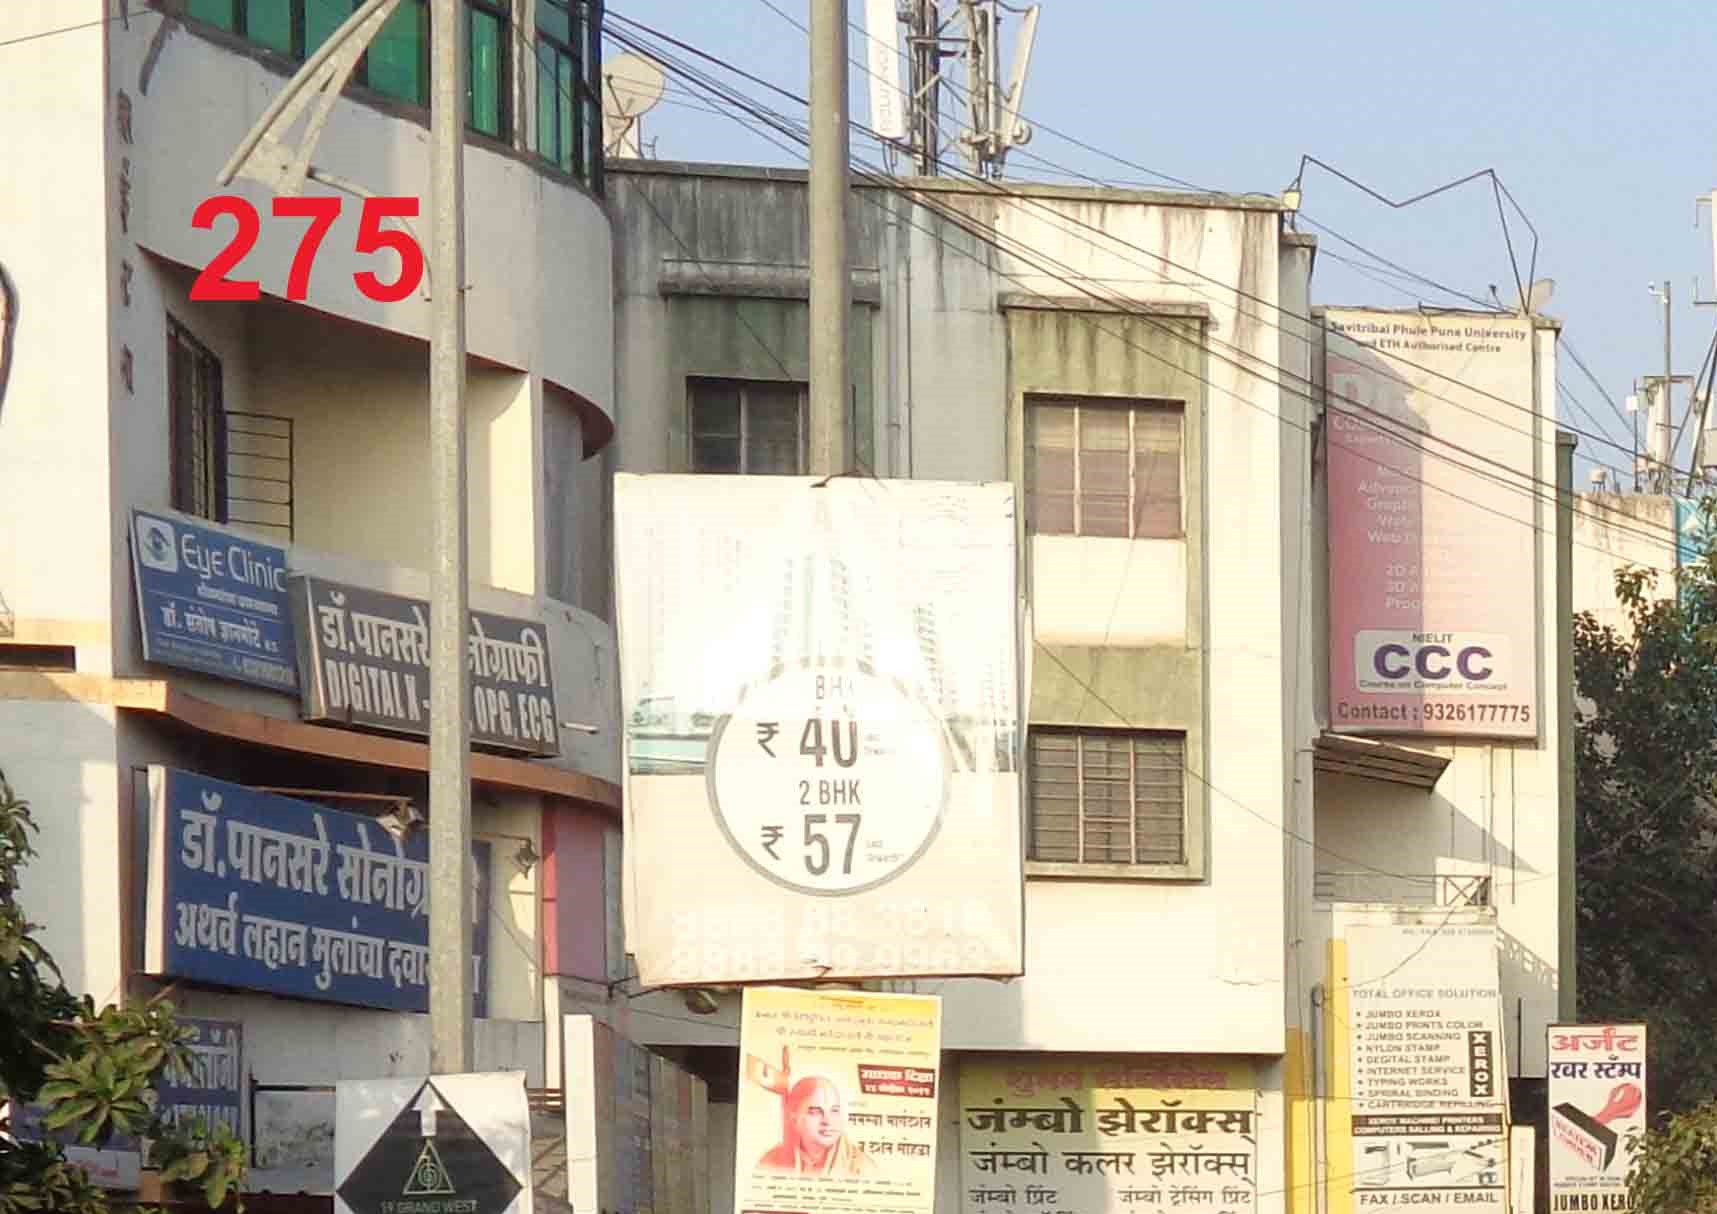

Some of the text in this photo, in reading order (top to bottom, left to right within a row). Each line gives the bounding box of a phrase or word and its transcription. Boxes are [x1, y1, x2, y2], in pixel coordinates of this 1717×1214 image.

[181, 534, 287, 592] Eye Clinic
[1374, 643, 1493, 681] CCC
[325, 658, 404, 721] DIGITAL
[519, 694, 556, 744] ECG
[1338, 703, 1407, 721] Contact
[799, 779, 861, 805] 2 BHK
[803, 813, 862, 876] 57
[1470, 1032, 1490, 1096] XEROX
[1060, 1150, 1136, 1176] कलर
[1360, 1192, 1499, 1205] FAX SCAN EMAIL
[1554, 1193, 1598, 1212] JUMBO
